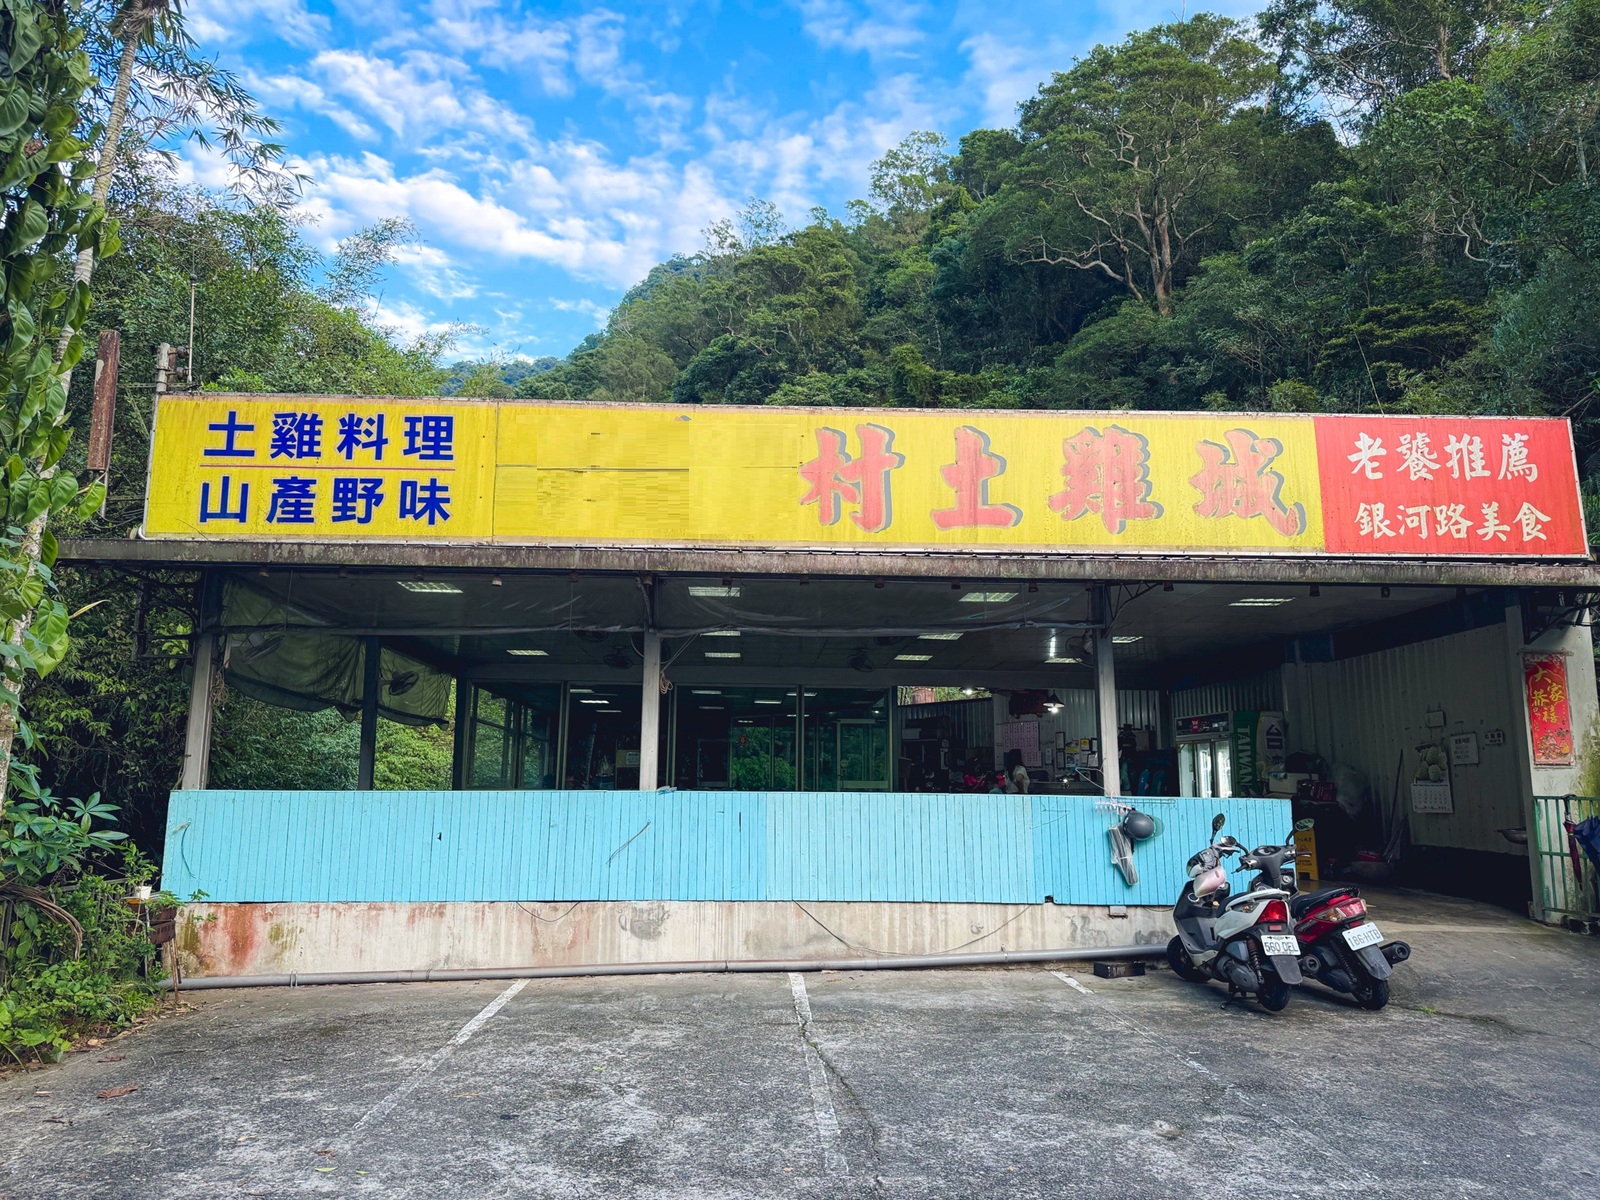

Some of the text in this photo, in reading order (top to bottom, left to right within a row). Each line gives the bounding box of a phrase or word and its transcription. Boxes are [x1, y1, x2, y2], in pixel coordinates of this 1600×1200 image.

[203, 411, 454, 461] 土雞料理
[1347, 432, 1538, 482] 老饕推薦
[200, 476, 452, 526] 山產野味
[799, 422, 1308, 536] 村土雞城
[1354, 501, 1552, 542] 銀河路美食
[1237, 724, 1253, 786] TAIWAN
